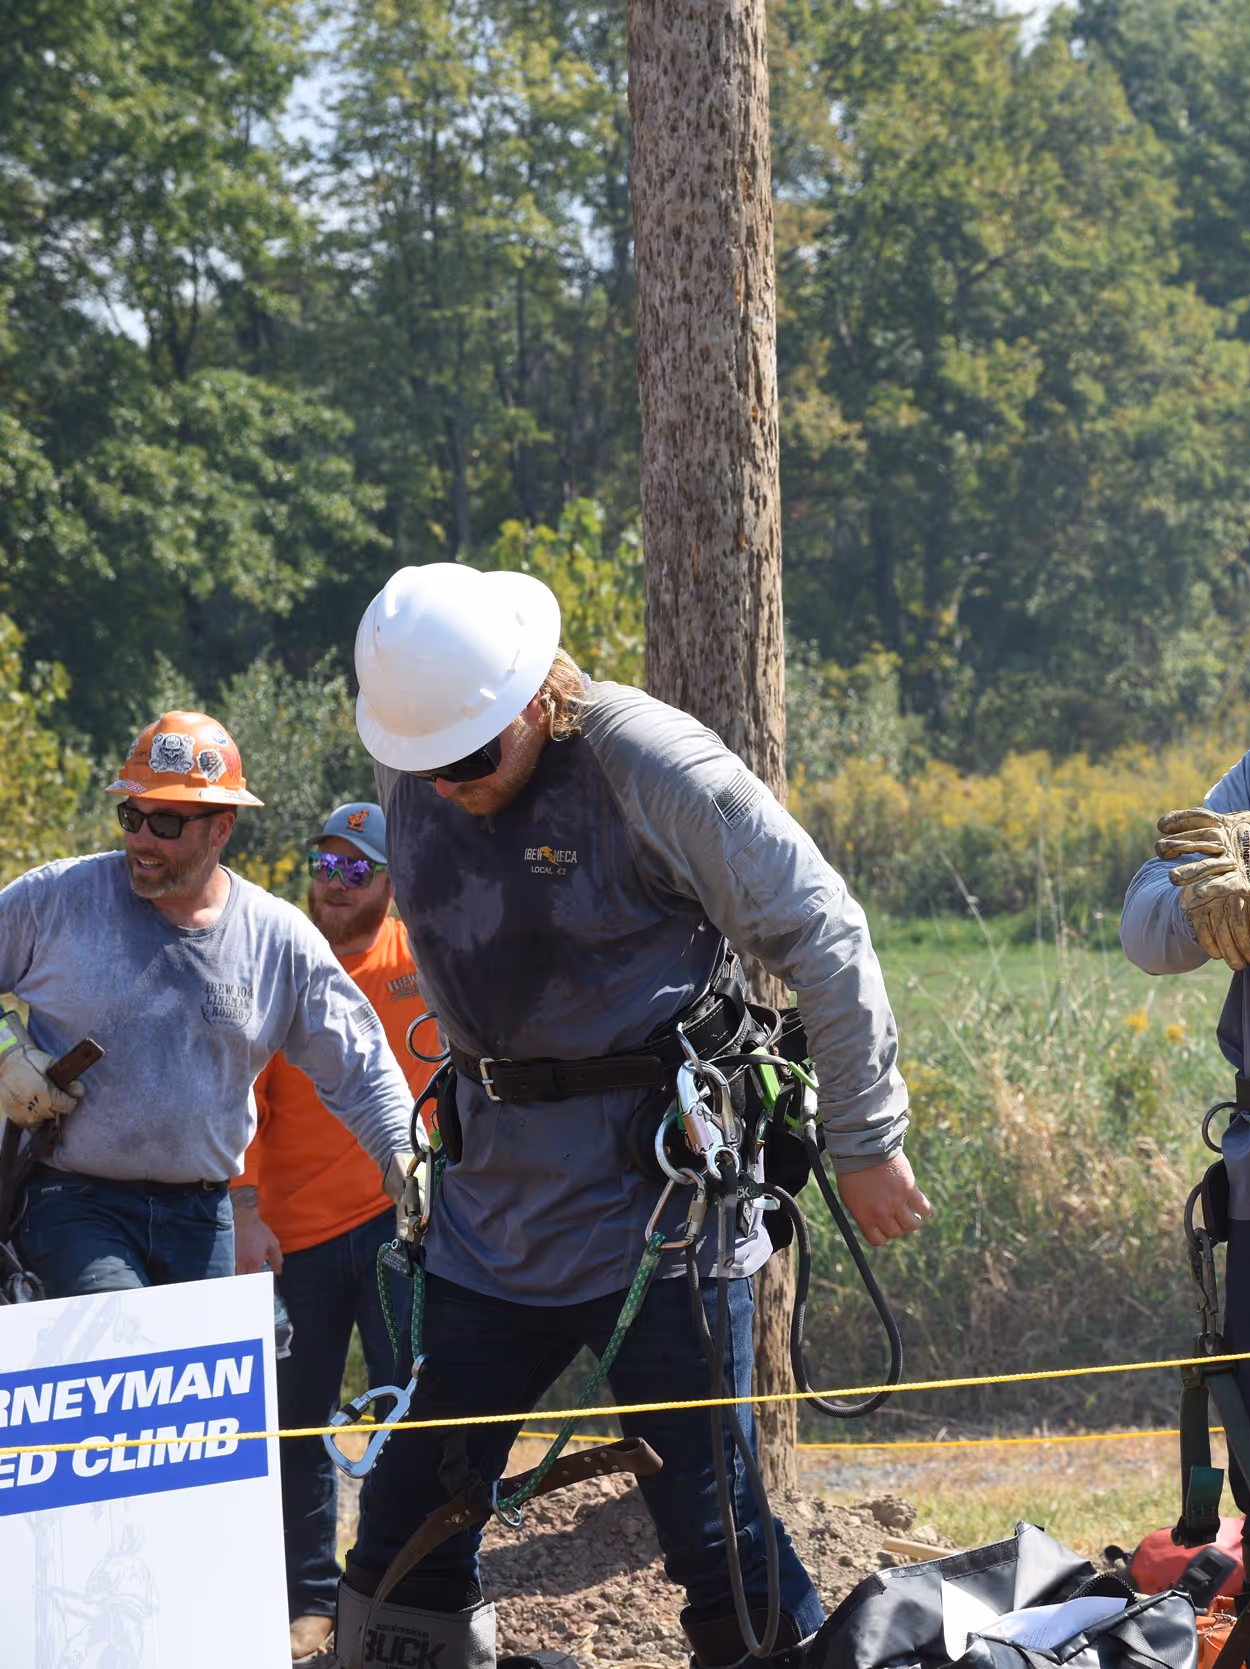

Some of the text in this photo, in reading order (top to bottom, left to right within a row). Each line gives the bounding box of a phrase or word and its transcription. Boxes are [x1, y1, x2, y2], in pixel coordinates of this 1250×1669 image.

[524, 848, 578, 864] IBEW NECA
[531, 866, 567, 876] LOCAL 42
[206, 981, 234, 995] IBEW
[206, 994, 250, 1009] LINEMAN
[212, 1006, 244, 1020] RODEO
[0, 1355, 254, 1428] NEYMAN
[72, 1417, 240, 1477] CLIMB
